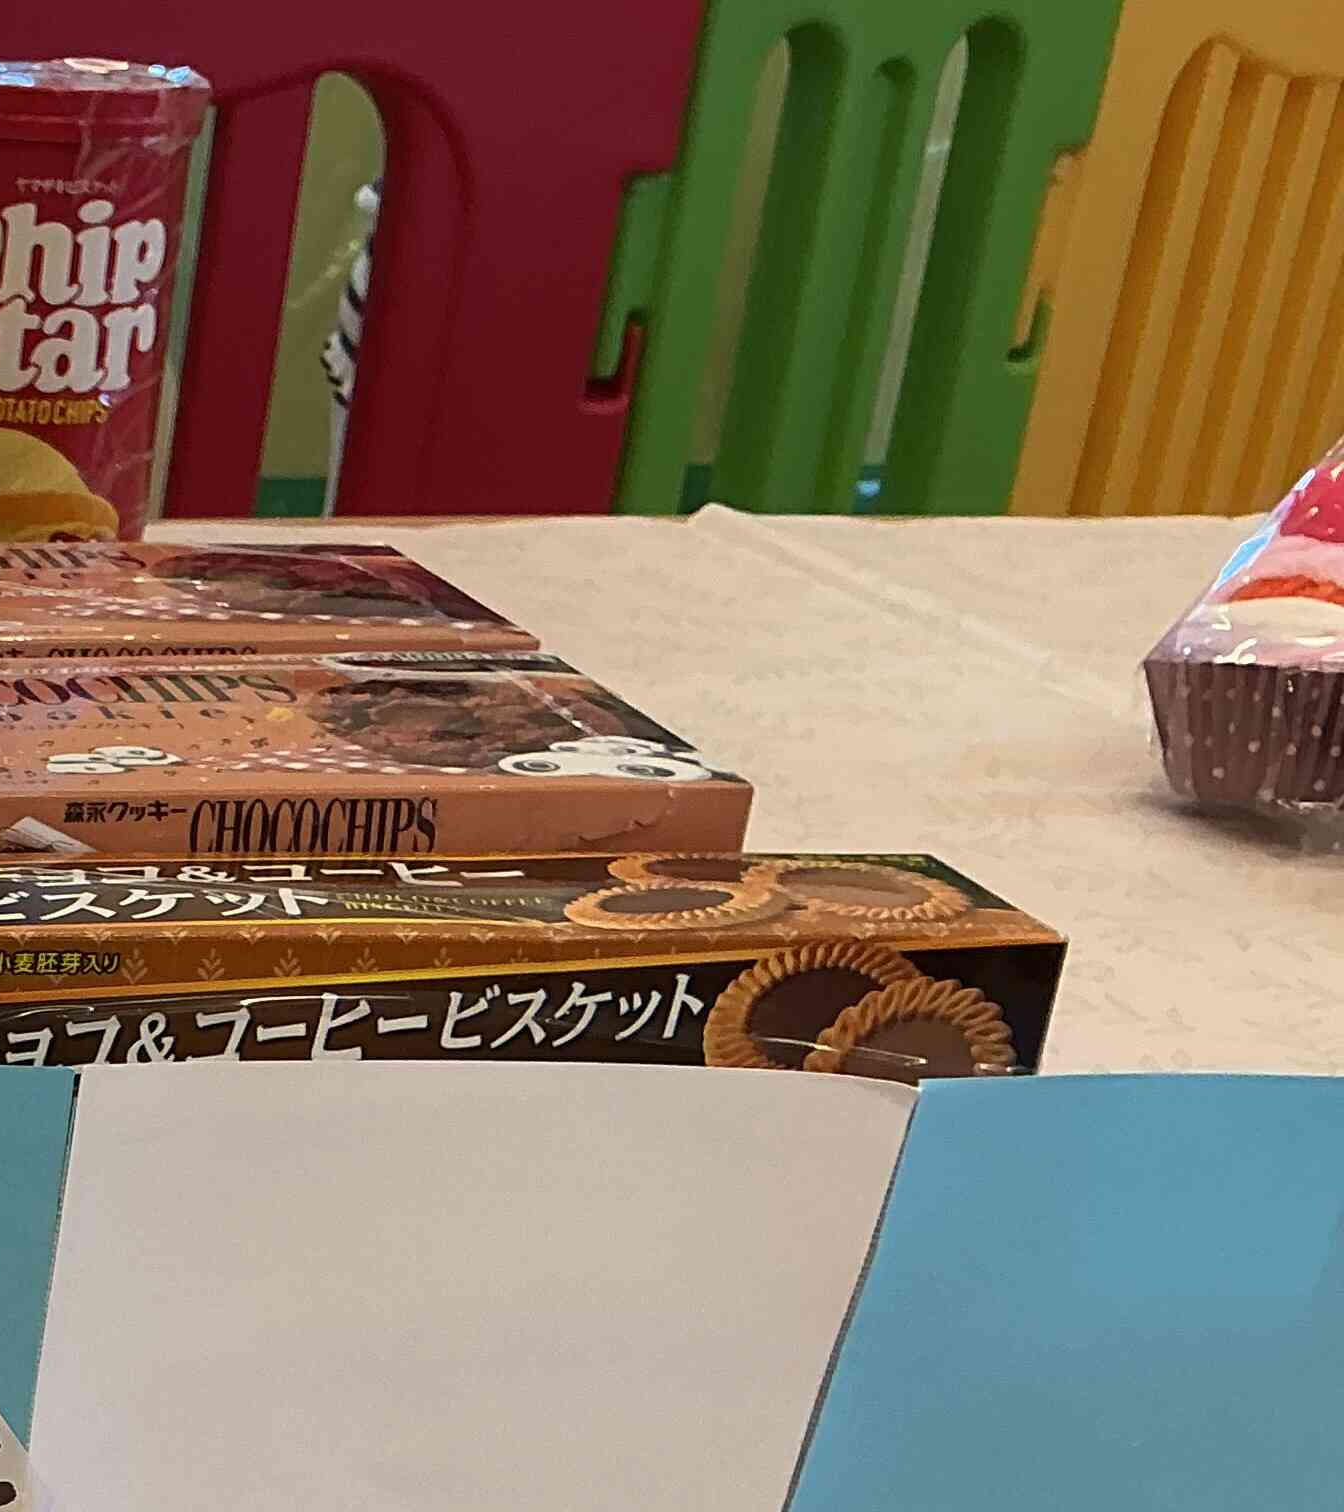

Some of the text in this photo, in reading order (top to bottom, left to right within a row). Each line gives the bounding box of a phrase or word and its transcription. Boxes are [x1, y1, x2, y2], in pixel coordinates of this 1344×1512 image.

[64, 798, 439, 853] 森永クッキー CHOCOCHIPS
